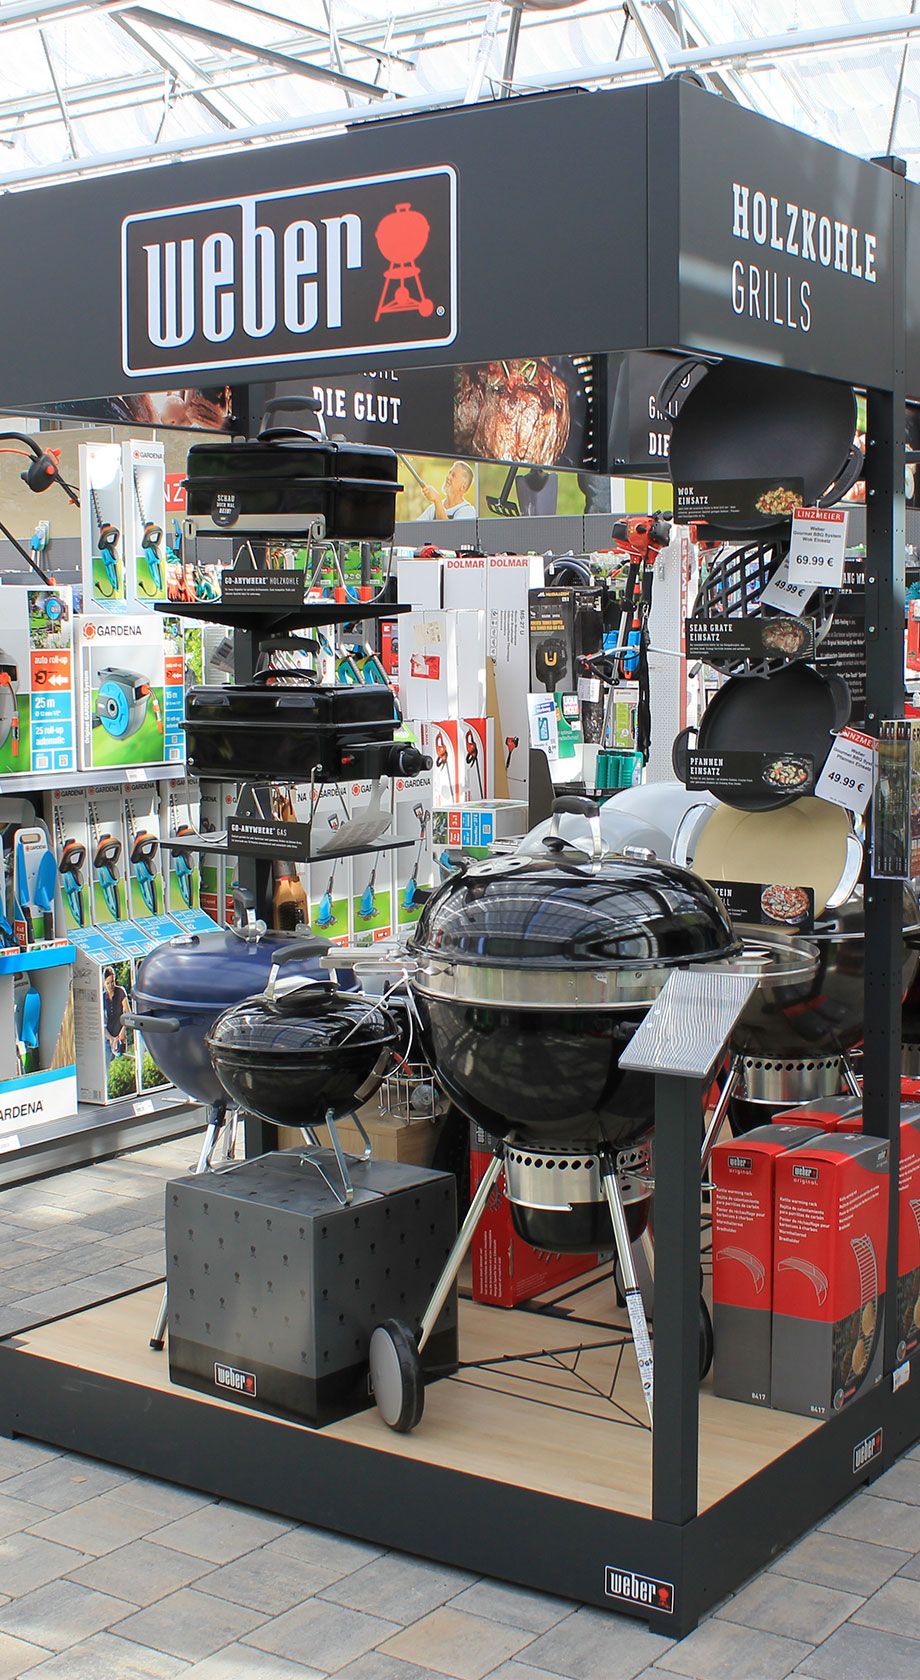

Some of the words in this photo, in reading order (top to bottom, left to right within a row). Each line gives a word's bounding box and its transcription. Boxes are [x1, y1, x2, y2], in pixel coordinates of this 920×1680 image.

[732, 182, 877, 283] HOLZKOHLE
[142, 200, 362, 348] weber
[732, 260, 811, 332] GRILLS
[313, 386, 346, 418] DIE
[354, 392, 401, 424] GLUT
[678, 496, 708, 505] EINSATZ
[797, 510, 841, 520] LINZMEIER
[447, 560, 485, 569] DOLMAR
[490, 559, 528, 568] DOLMAR
[796, 555, 824, 566] 69.99
[827, 558, 834, 567] €
[775, 580, 798, 594] 49.99
[798, 588, 806, 597] €
[97, 626, 142, 636] GARDENA
[34, 656, 48, 664] auto
[49, 656, 68, 665] roll-up
[34, 697, 46, 708] 25
[46, 699, 55, 708] m
[35, 727, 44, 735] 25
[44, 726, 64, 735] roll-up
[36, 737, 65, 745] automatic
[690, 757, 724, 766] PFANNEN
[690, 766, 720, 776] EINSATZ
[131, 783, 155, 791] GARDENA
[405, 778, 431, 788] GARDENA
[828, 772, 855, 788] 49.99
[858, 783, 864, 792] €
[277, 829, 287, 837] GAS
[730, 1157, 746, 1167] weber
[794, 1166, 812, 1177] weber
[217, 1367, 245, 1390] weber
[810, 1406, 825, 1414] 8417
[856, 1438, 875, 1468] weber
[610, 1572, 656, 1603] weber
